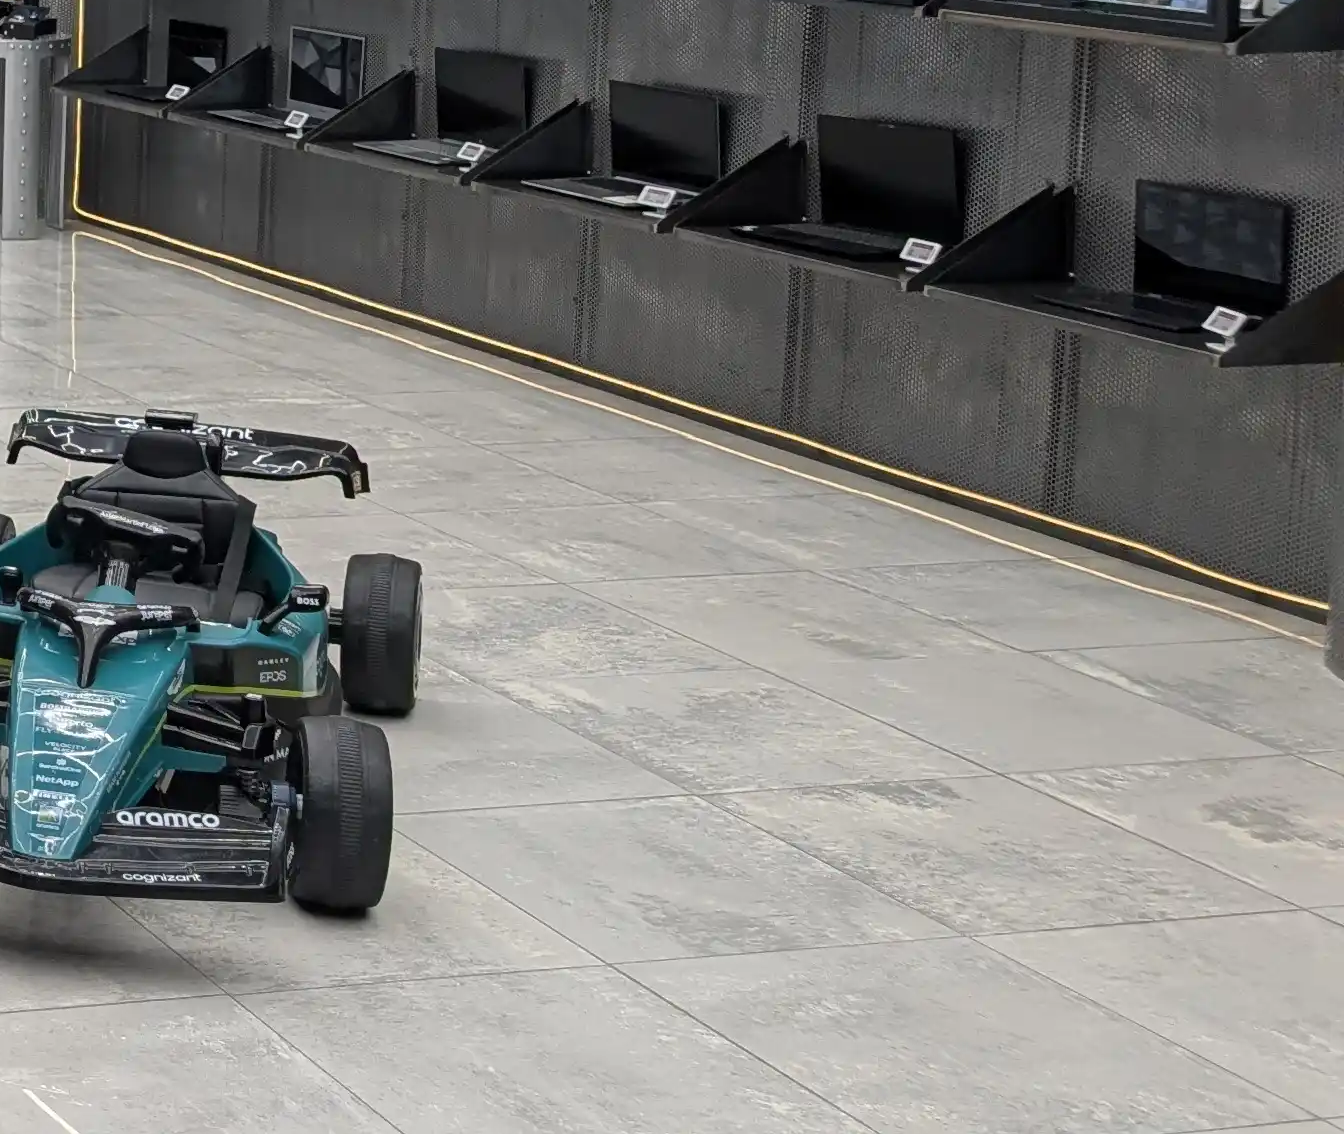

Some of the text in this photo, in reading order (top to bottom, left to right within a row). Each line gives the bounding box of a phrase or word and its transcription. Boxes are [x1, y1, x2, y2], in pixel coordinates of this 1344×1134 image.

[115, 417, 255, 441] cozant
[296, 596, 320, 606] BOSS
[259, 670, 287, 683] EPOS
[36, 774, 80, 787] NetApp
[116, 811, 220, 828] aramco
[122, 872, 202, 883] cognizant
